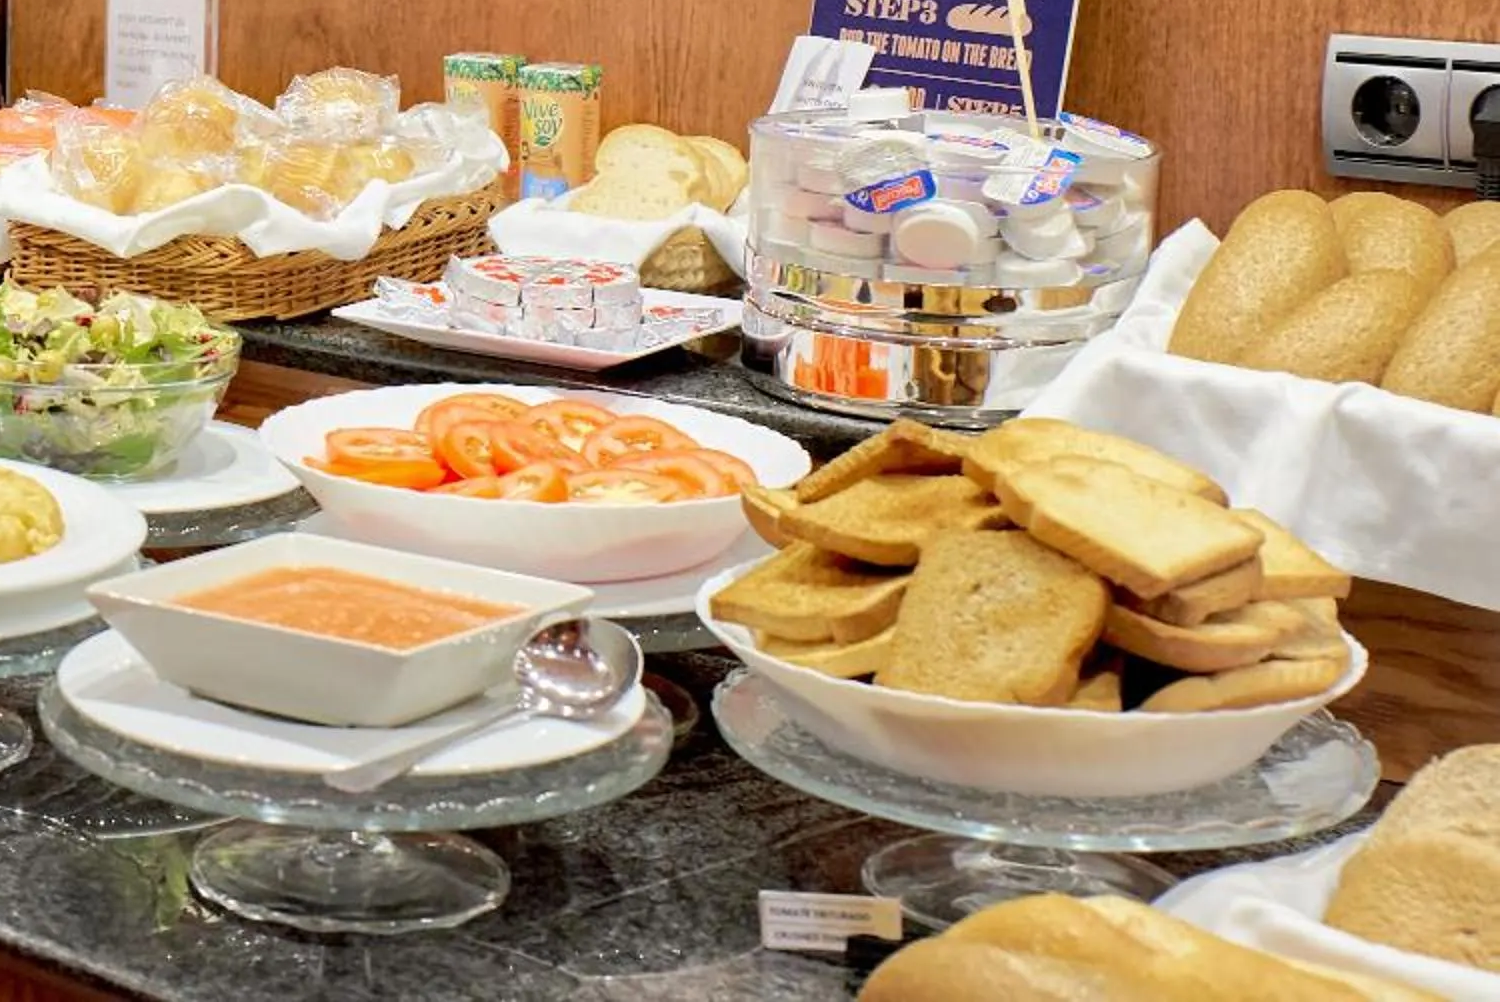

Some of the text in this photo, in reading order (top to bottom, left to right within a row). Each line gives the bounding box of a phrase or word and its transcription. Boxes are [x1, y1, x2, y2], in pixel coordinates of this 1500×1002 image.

[867, 31, 890, 55] THE
[891, 34, 941, 61] TOMATO
[942, 39, 962, 64] ON
[963, 42, 989, 67] THE
